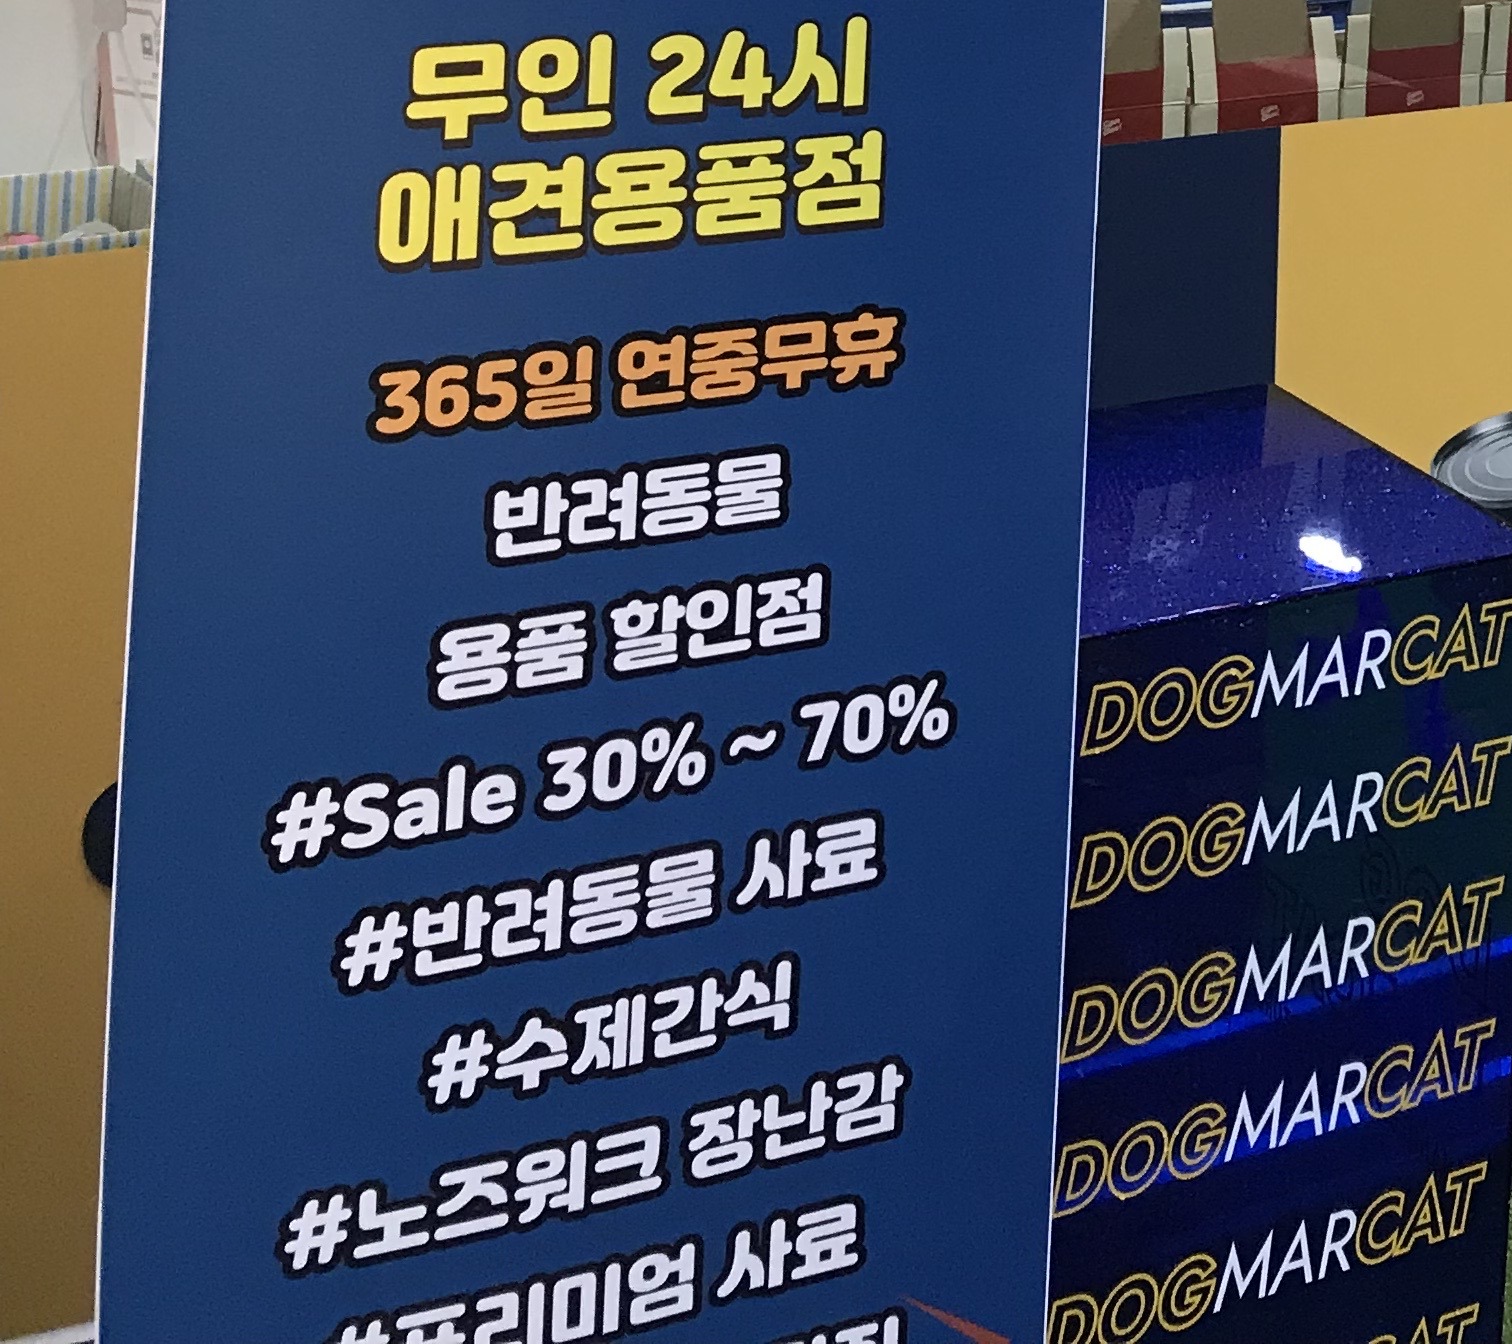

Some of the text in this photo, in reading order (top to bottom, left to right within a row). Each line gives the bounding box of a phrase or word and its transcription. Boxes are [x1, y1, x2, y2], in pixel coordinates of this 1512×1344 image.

[404, 15, 870, 142] 무인 24시
[377, 129, 886, 268] 애견용품점
[373, 310, 901, 436] 365일 연중무휴
[493, 451, 785, 558] 반려동물
[435, 571, 825, 702] 용품 할인점
[271, 678, 951, 863] #Sale 30% ~ 70%
[1070, 736, 1512, 909] DOGMARCAT
[340, 818, 880, 987] #반려동물 사료
[1060, 876, 1505, 1064] DOGMARCAT
[427, 959, 795, 1105] #수제간식
[285, 1063, 903, 1271] #노즈워크 장난감
[1052, 1018, 1497, 1219] DOGMARCAT
[717, 1204, 861, 1296] 사료
[1047, 1162, 1488, 1344] DOGMARCAT
